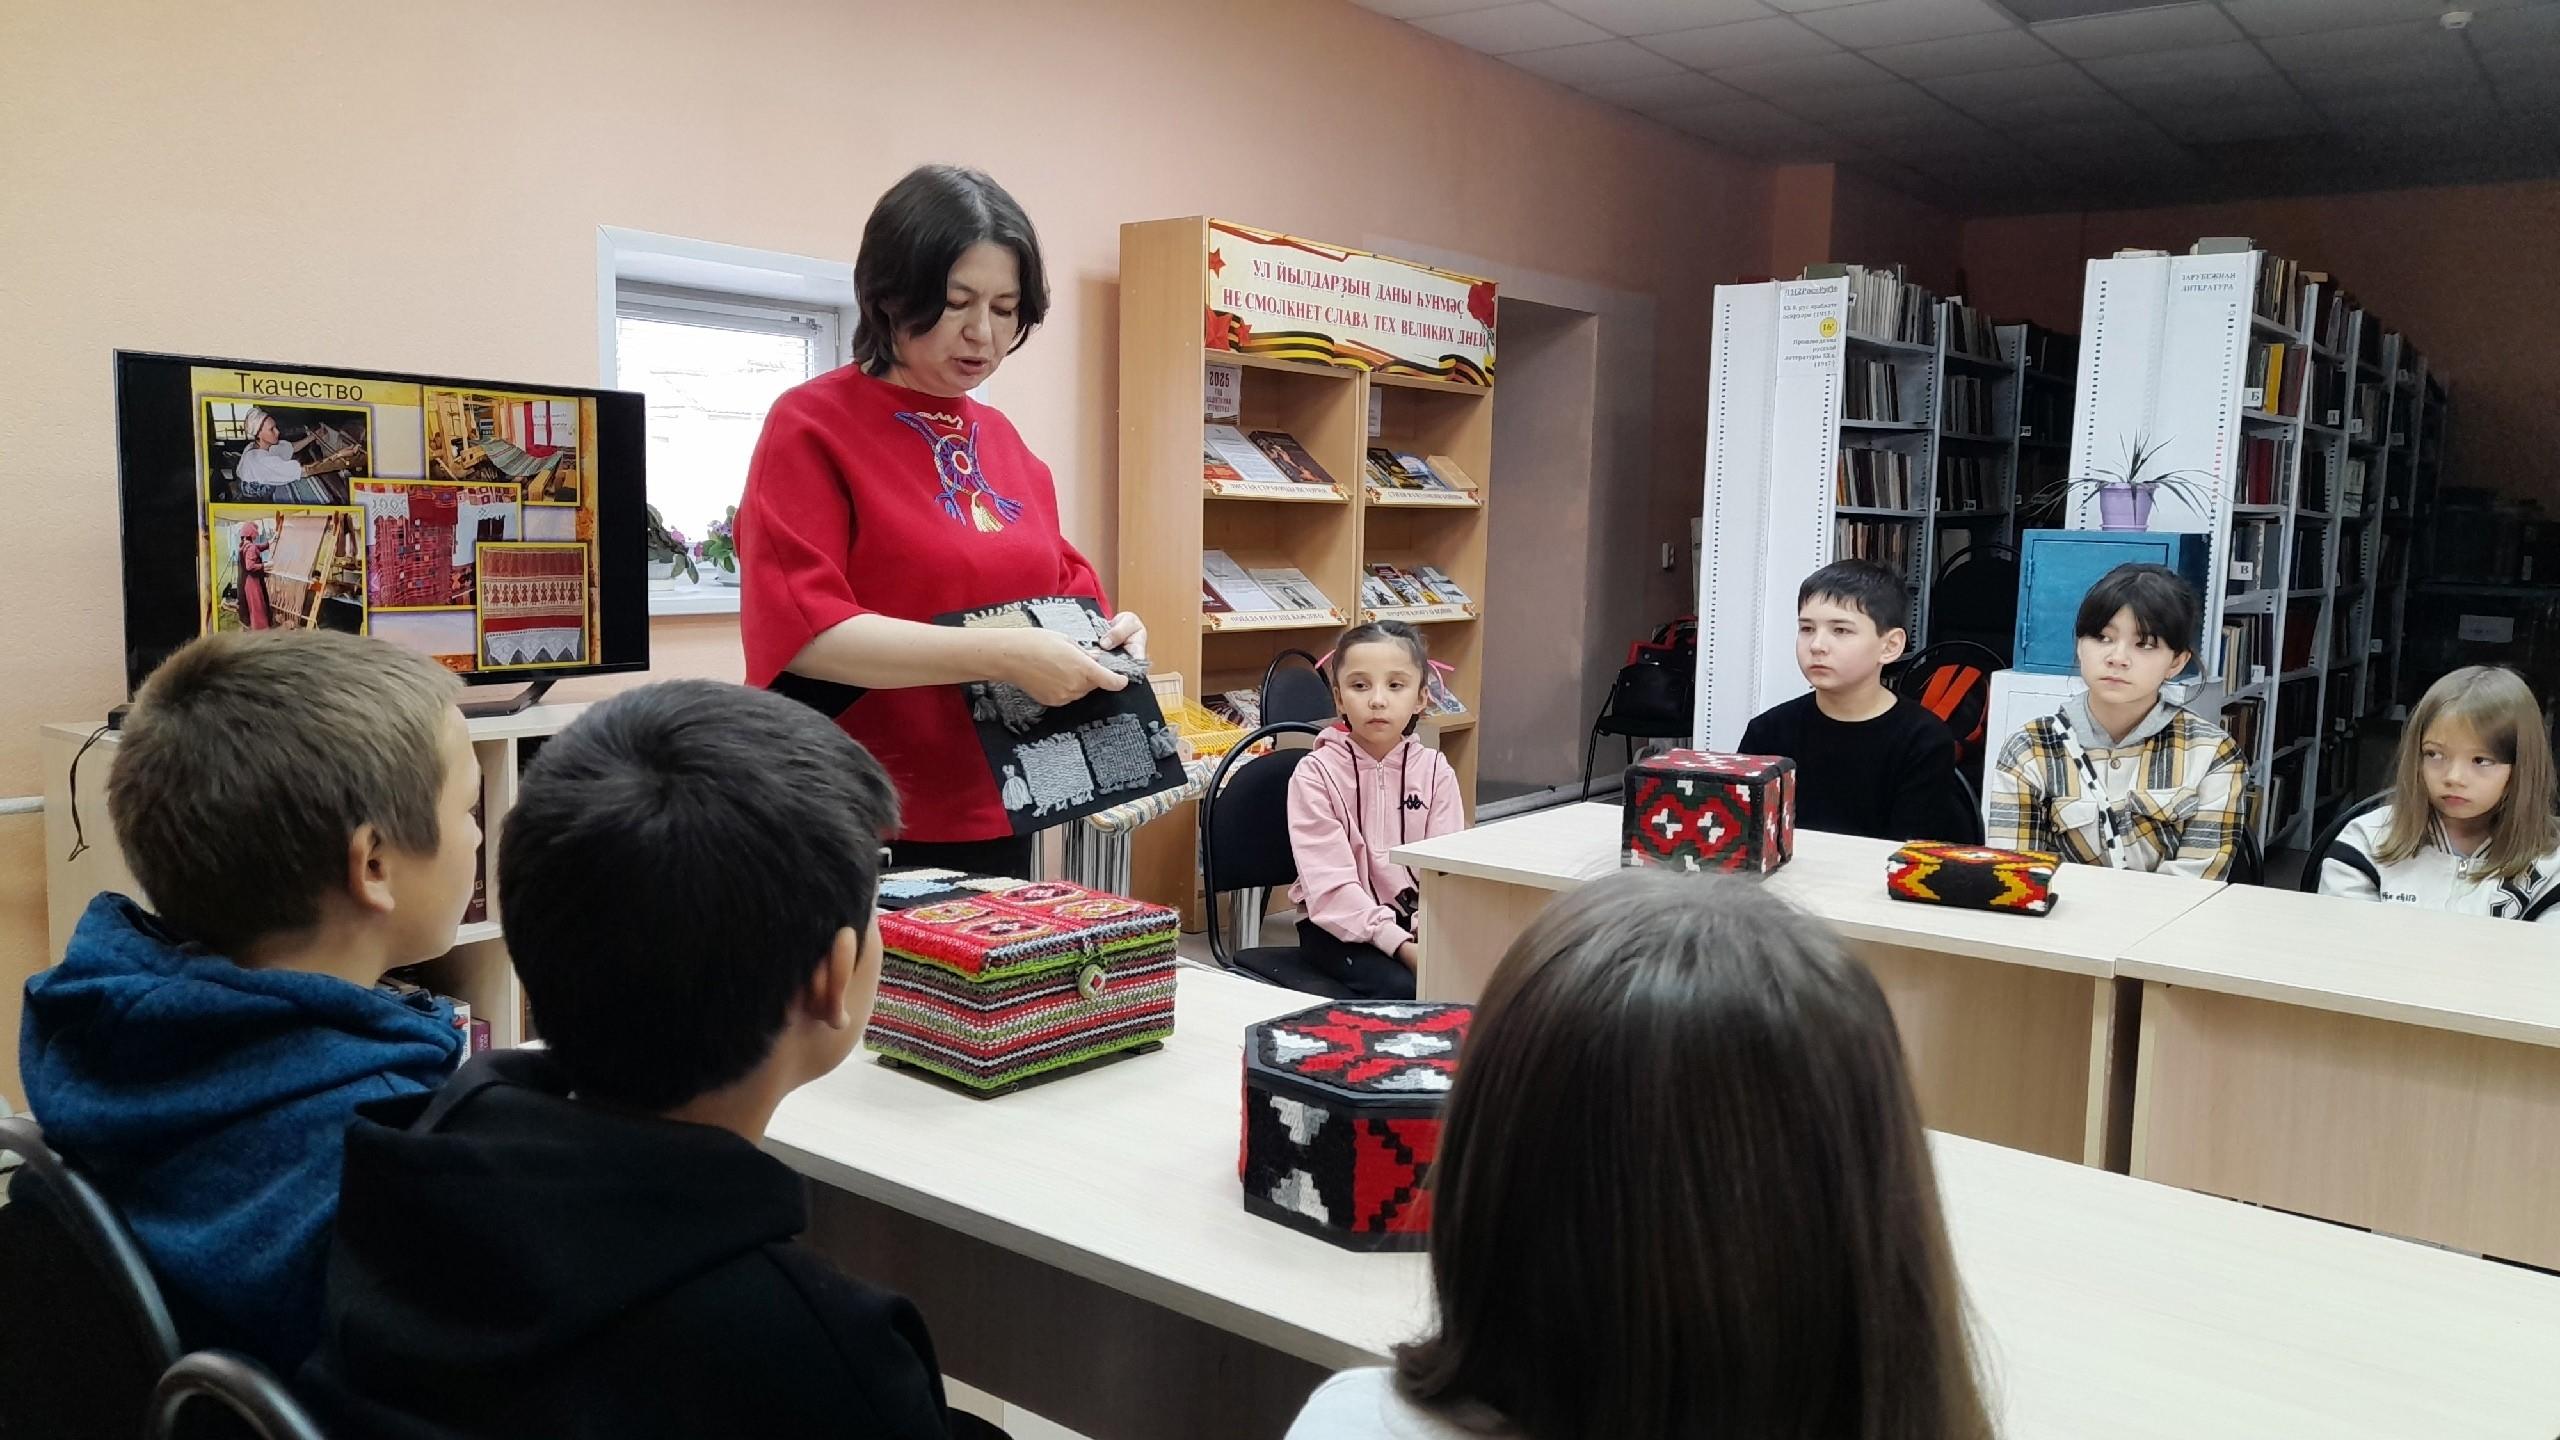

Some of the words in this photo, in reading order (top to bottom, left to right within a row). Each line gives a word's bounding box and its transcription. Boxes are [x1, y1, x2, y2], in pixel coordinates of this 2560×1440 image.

[1253, 259, 1271, 279] УЛ
[1375, 283, 1412, 305] ДАНЫ
[1223, 288, 1242, 308] НЕ
[1244, 292, 1323, 322] СМОЛКНЕТ
[1324, 307, 1369, 330] СЛАВА
[1374, 314, 1397, 334] ТЕХ
[1401, 319, 1455, 345] ВЕЛИКИХ
[233, 371, 363, 402] Ткачество
[1209, 371, 1230, 388] 2025
